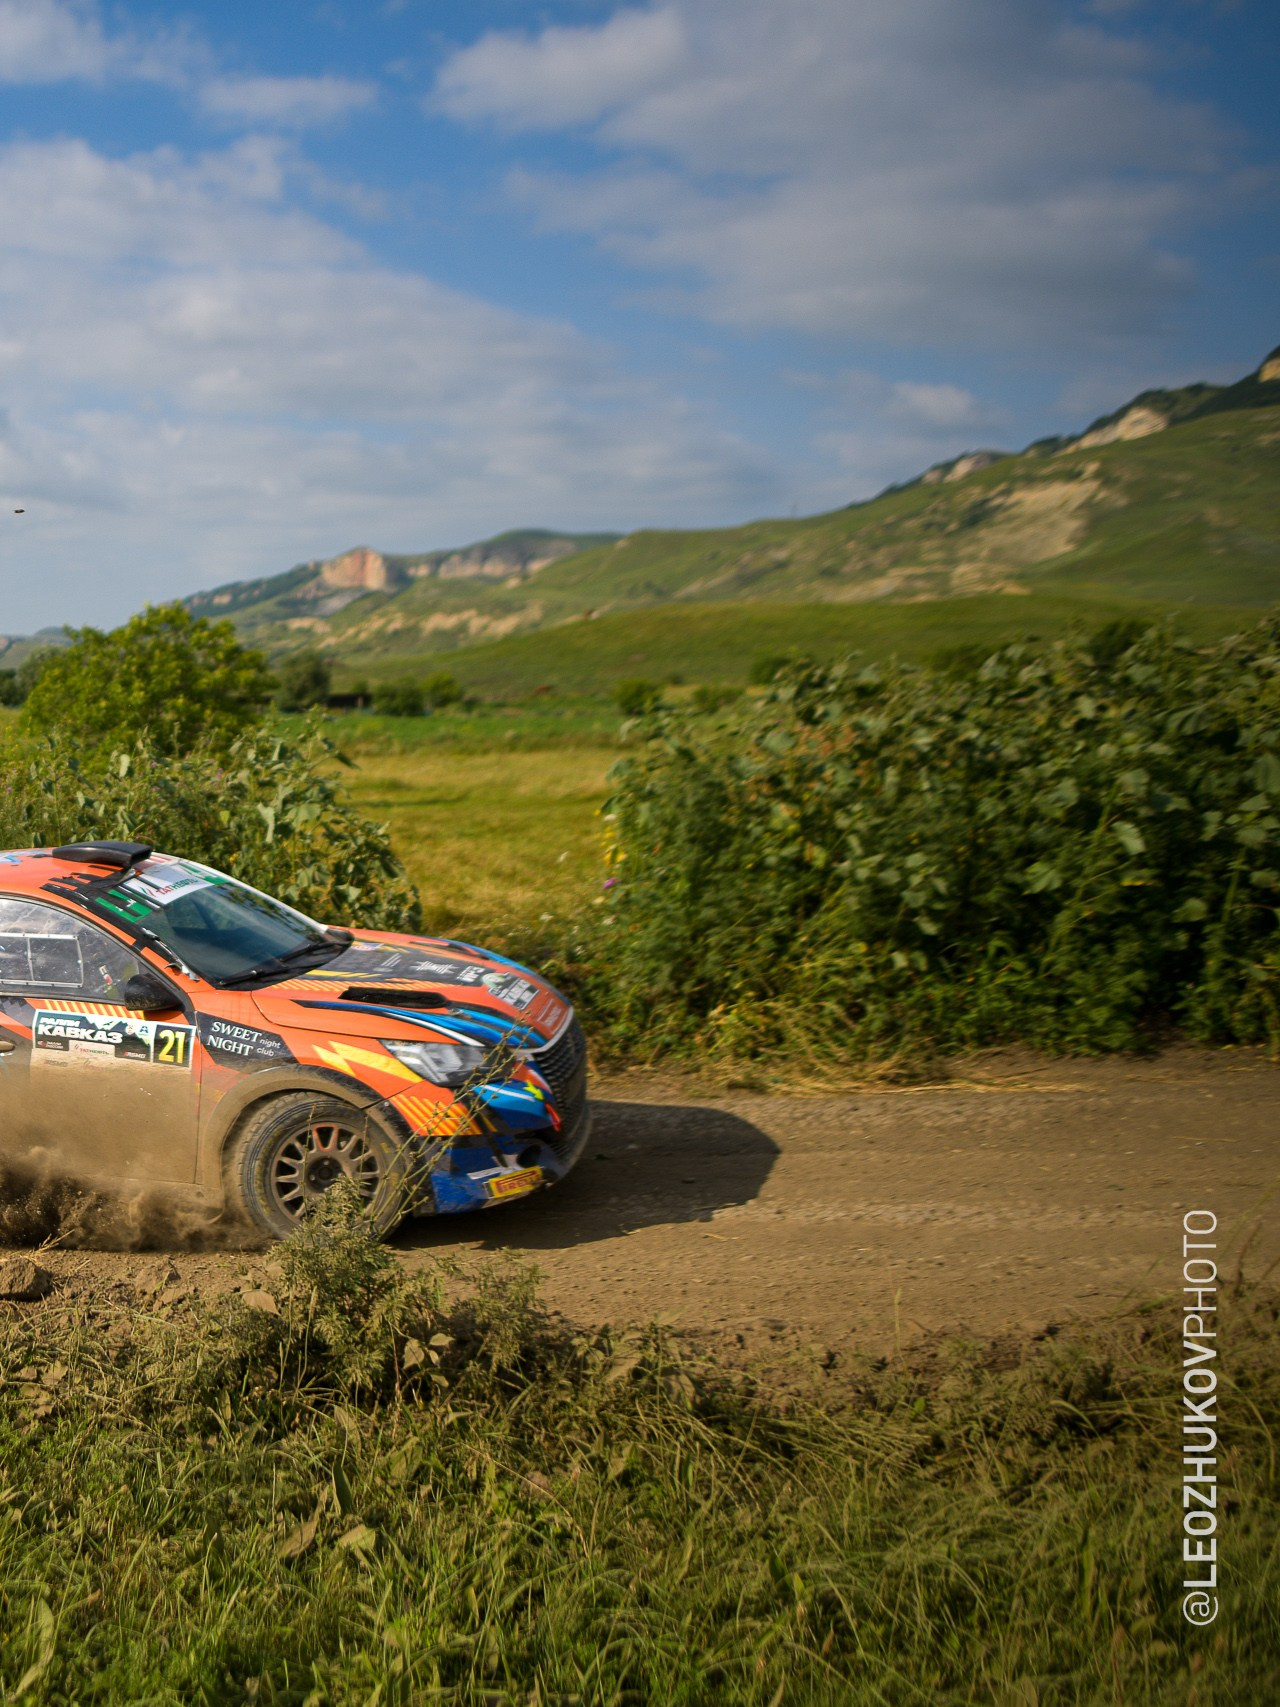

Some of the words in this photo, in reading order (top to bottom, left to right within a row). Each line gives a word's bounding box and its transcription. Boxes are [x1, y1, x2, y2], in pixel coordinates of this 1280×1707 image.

[37, 1023, 123, 1044] КАВКАЗ
[211, 1021, 262, 1042] SWEET
[158, 1029, 186, 1064] 21
[207, 1034, 254, 1056] NIGHT
[256, 1047, 275, 1057] club
[260, 1038, 281, 1049] night
